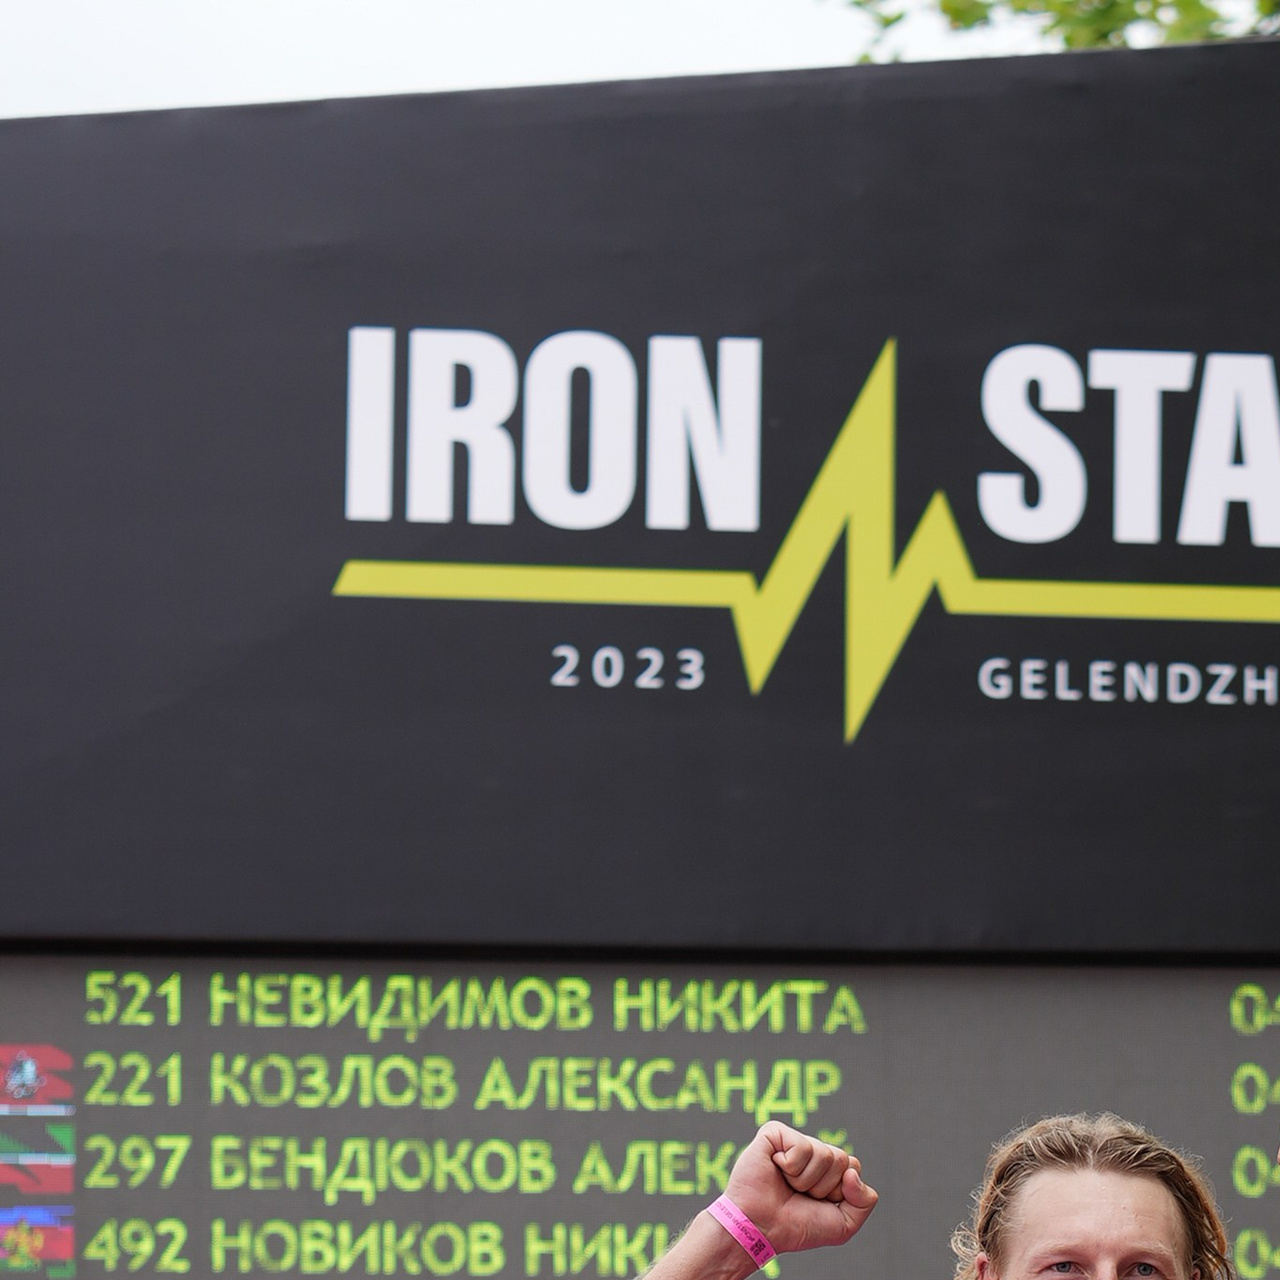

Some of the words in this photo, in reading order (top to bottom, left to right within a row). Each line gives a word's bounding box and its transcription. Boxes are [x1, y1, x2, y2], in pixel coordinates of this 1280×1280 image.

[344, 325, 763, 533] IRON
[550, 645, 707, 693] 2023
[84, 970, 184, 1027] 521
[208, 972, 595, 1043] НЕВИДИМОВ
[612, 976, 869, 1035] НИКИТА
[84, 1049, 184, 1107] 221
[209, 1051, 460, 1111] КОЗЛОВ
[472, 1055, 844, 1128] АЛЕКСАНДР
[84, 1132, 194, 1190] 297
[209, 1133, 557, 1207] БЕНДЮКОВ
[82, 1217, 192, 1274] 492
[209, 1217, 506, 1277] НОВИКОВ
